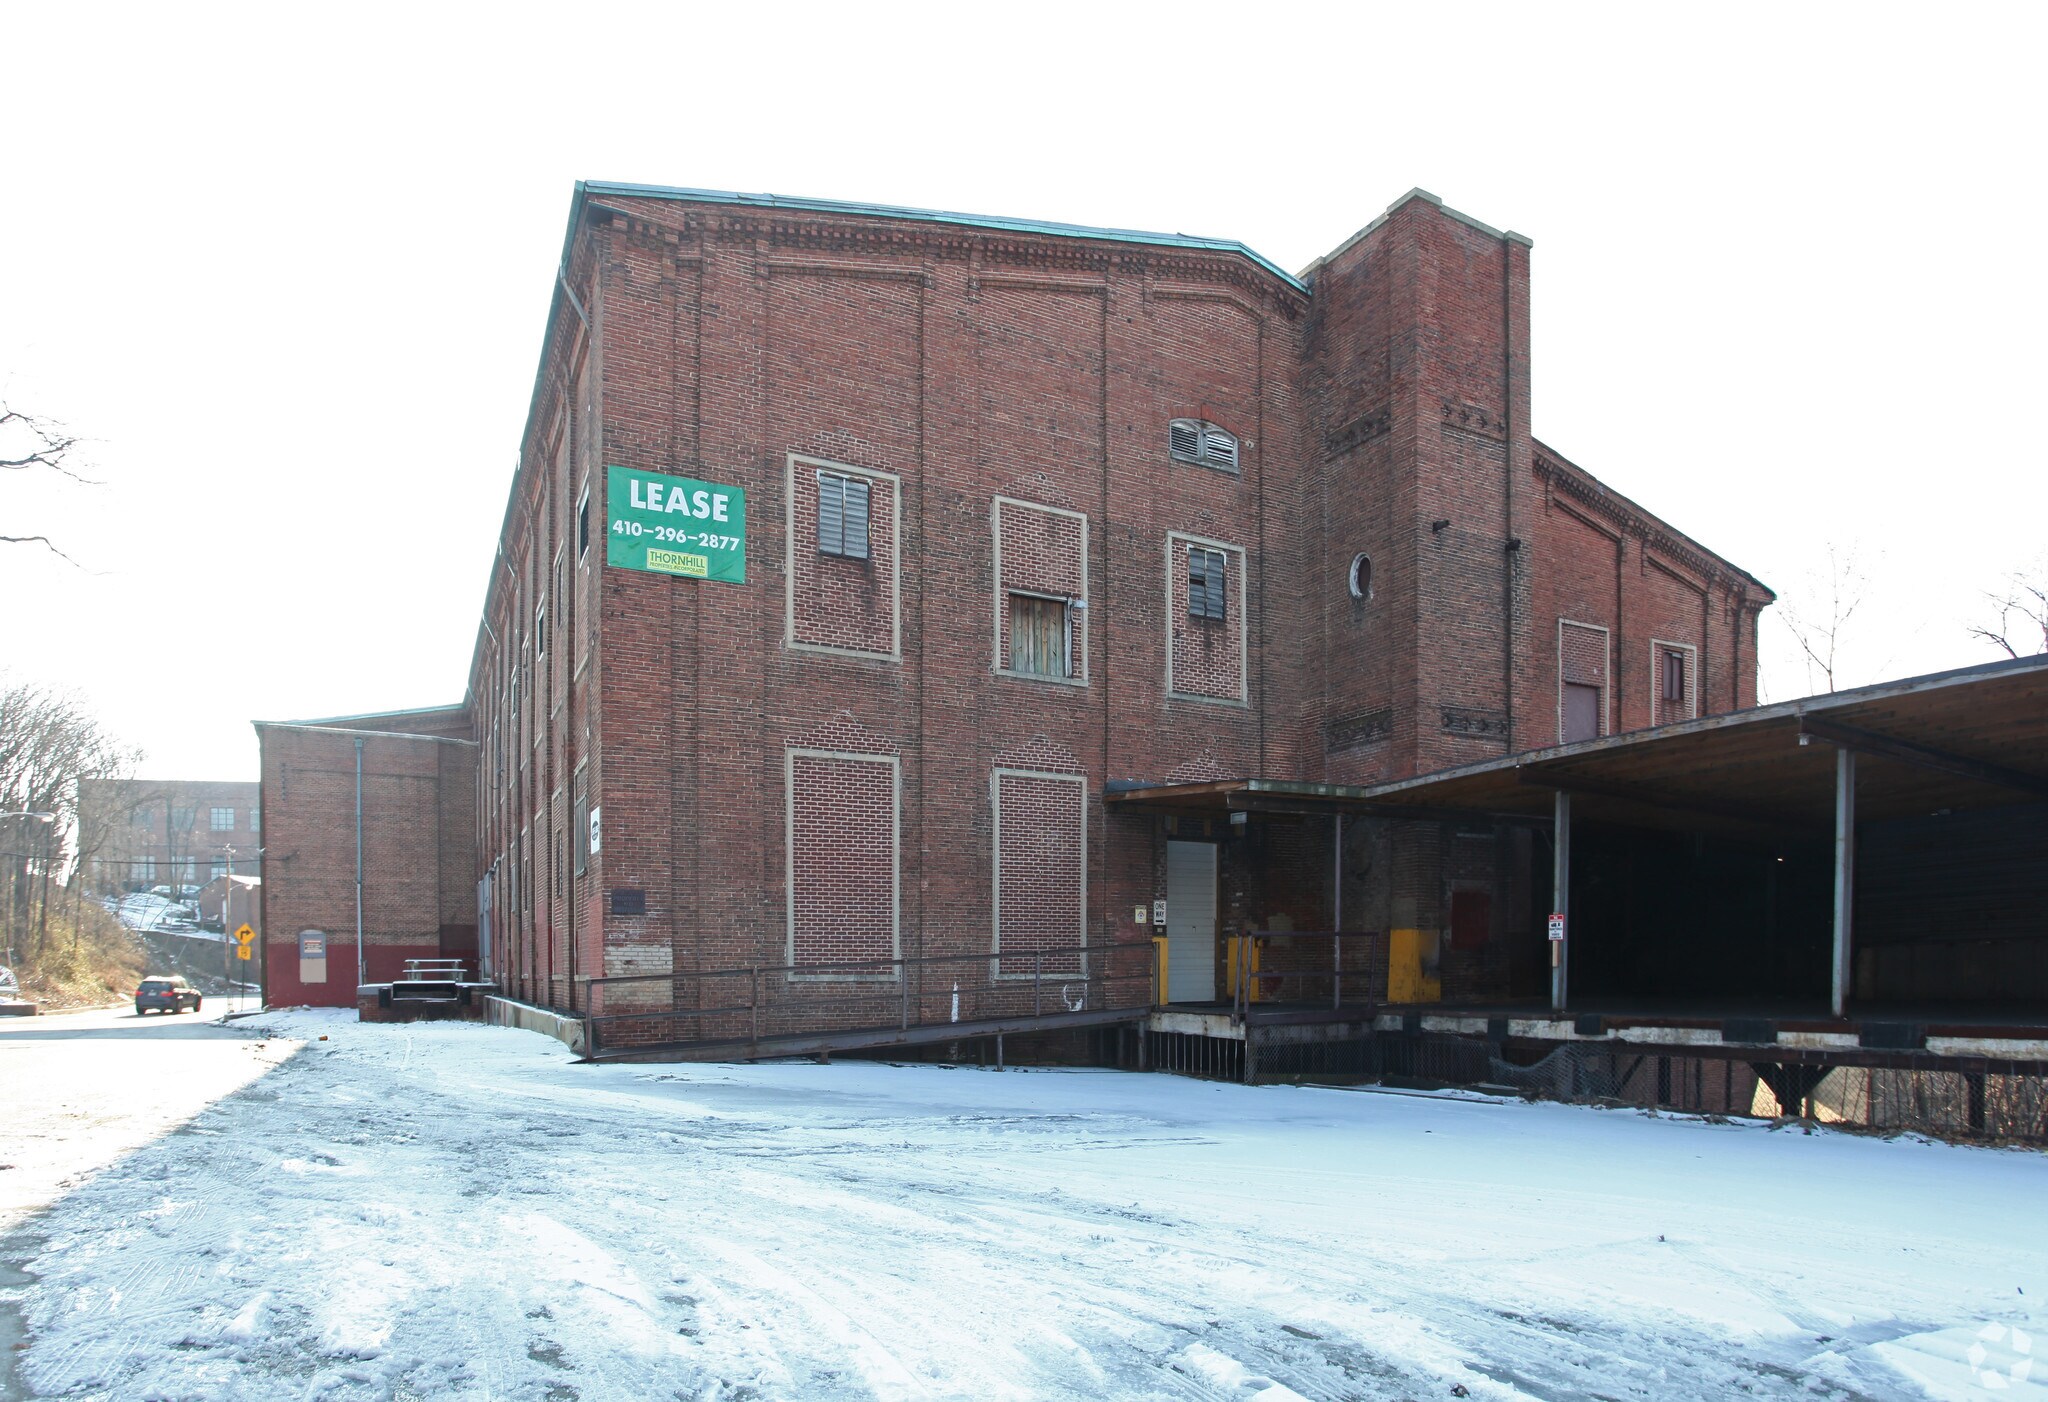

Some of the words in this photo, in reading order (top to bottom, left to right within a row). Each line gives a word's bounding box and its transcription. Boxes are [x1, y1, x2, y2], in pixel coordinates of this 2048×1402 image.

[630, 479, 728, 522] LEASE
[612, 519, 740, 551] 410-296-2877
[649, 551, 705, 568] THORNHILL
[1155, 902, 1165, 910] ONE
